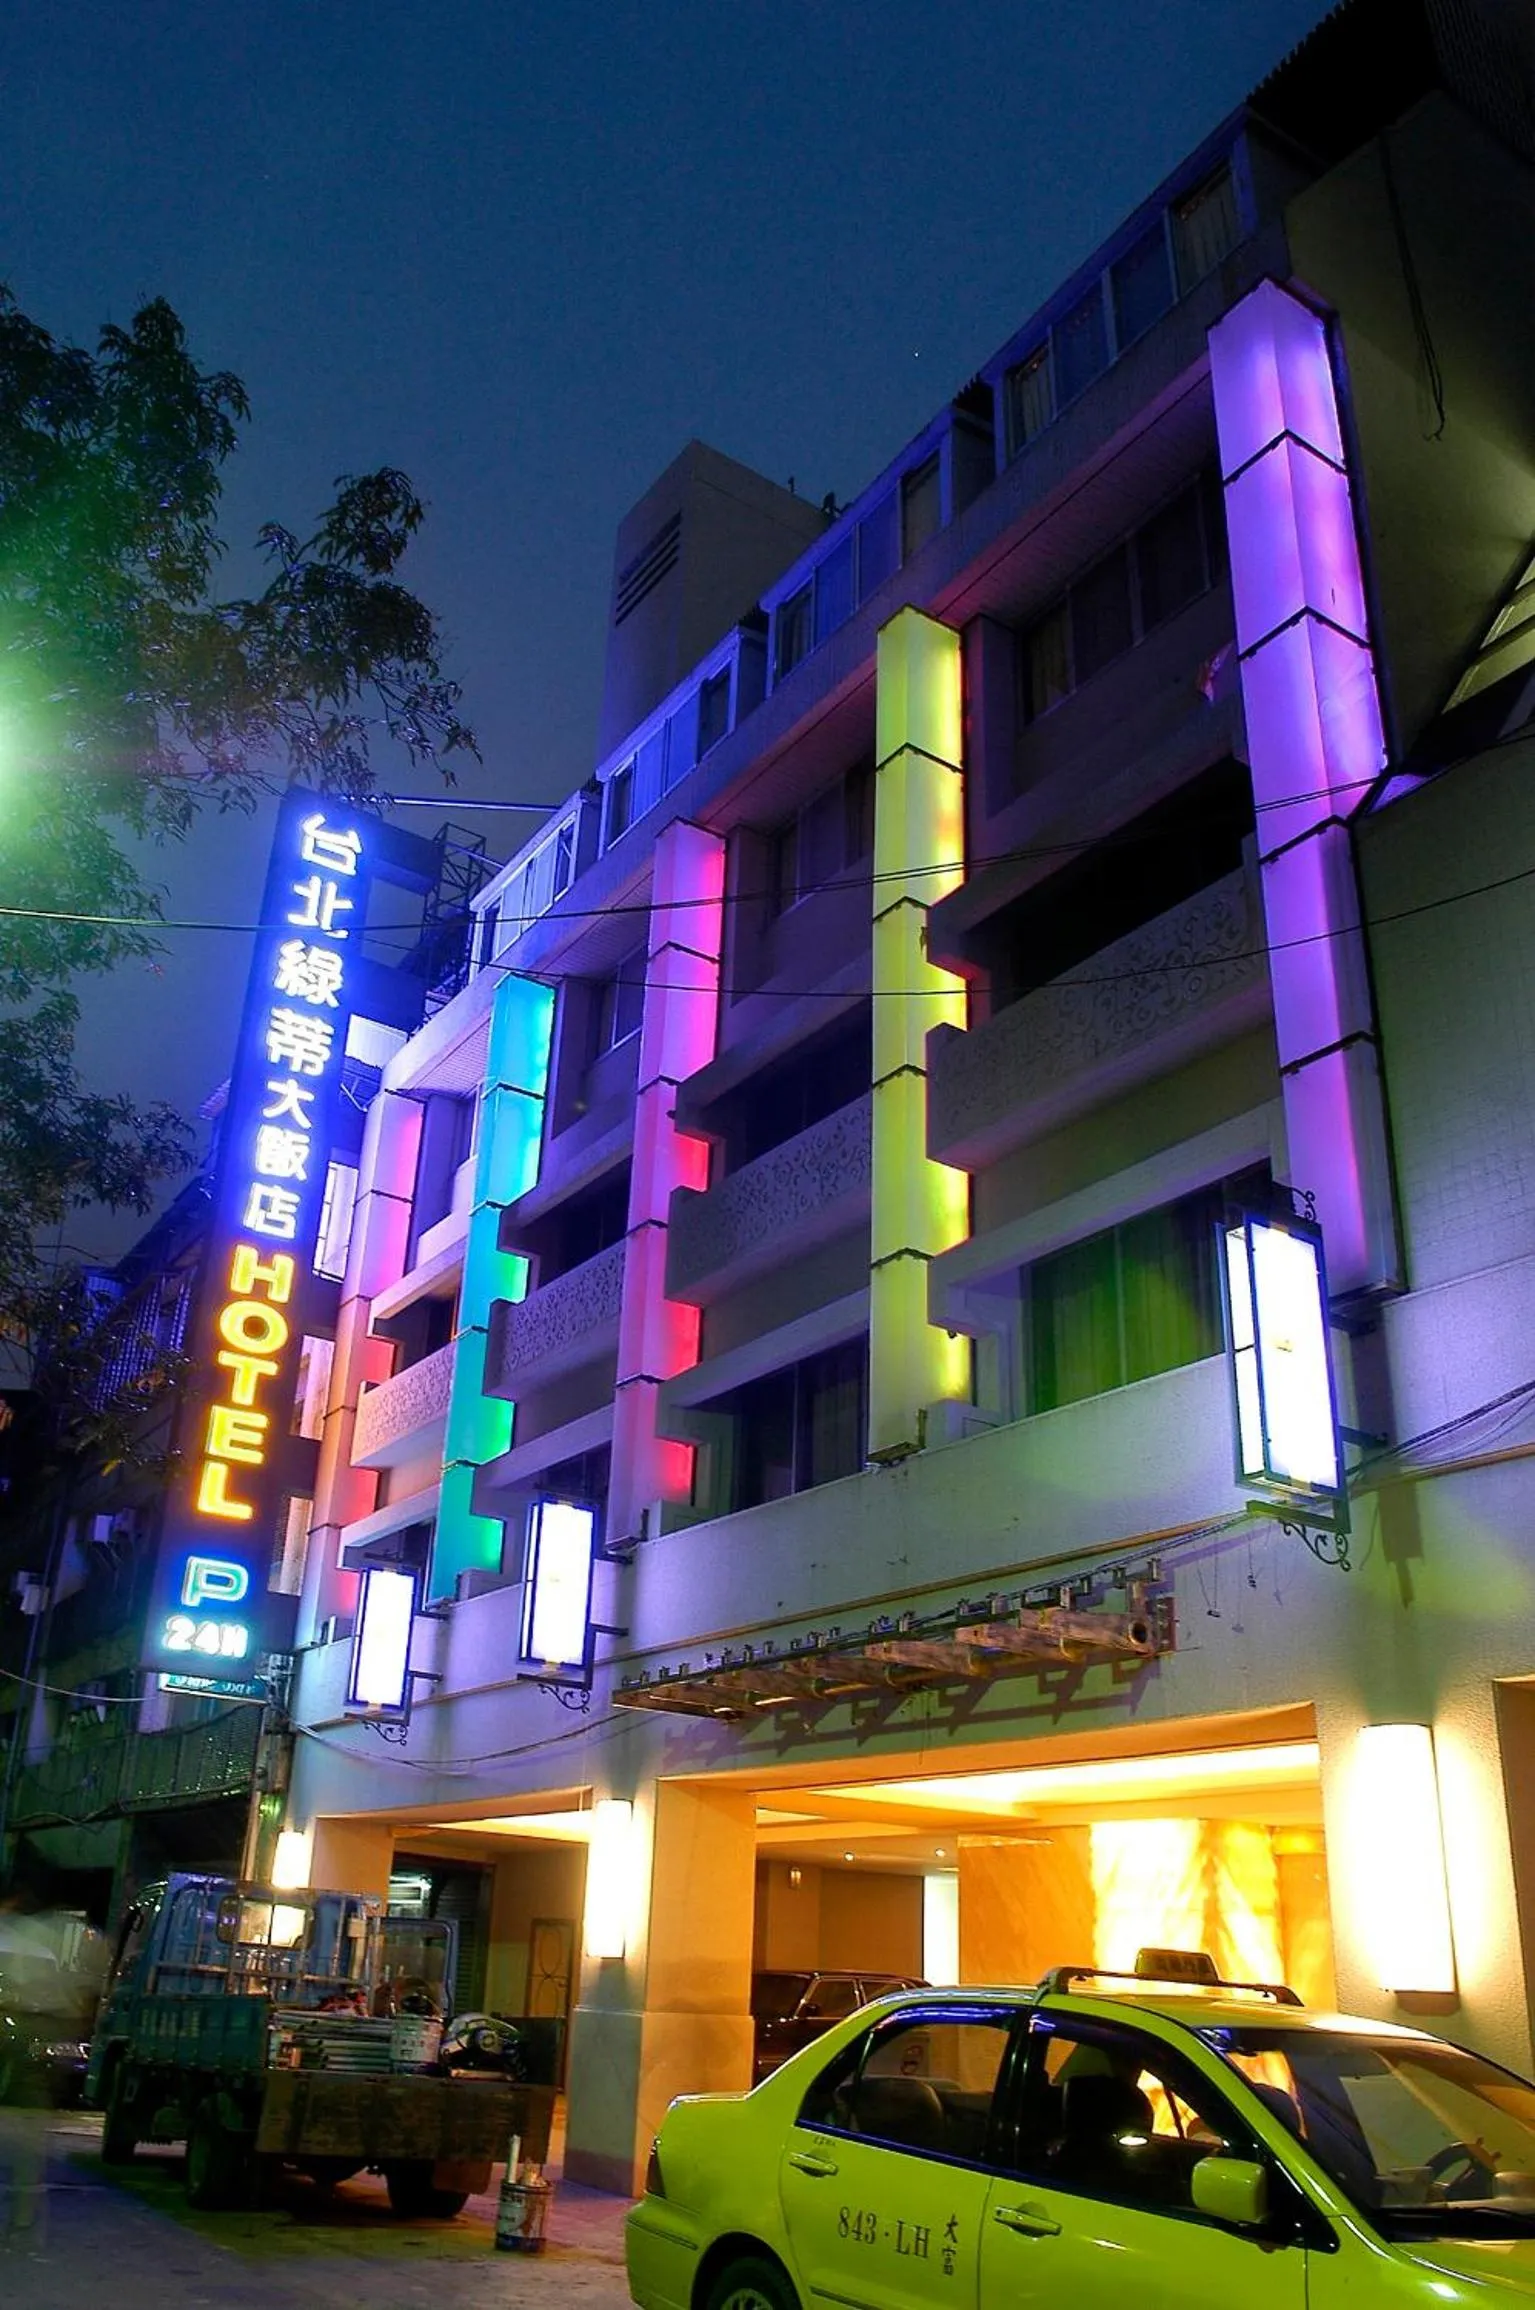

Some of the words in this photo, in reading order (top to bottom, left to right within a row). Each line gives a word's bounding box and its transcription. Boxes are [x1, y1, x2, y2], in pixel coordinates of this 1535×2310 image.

[196, 1243, 296, 1521] HOTEL
[181, 1555, 249, 1607] P
[161, 1614, 249, 1658] 24H
